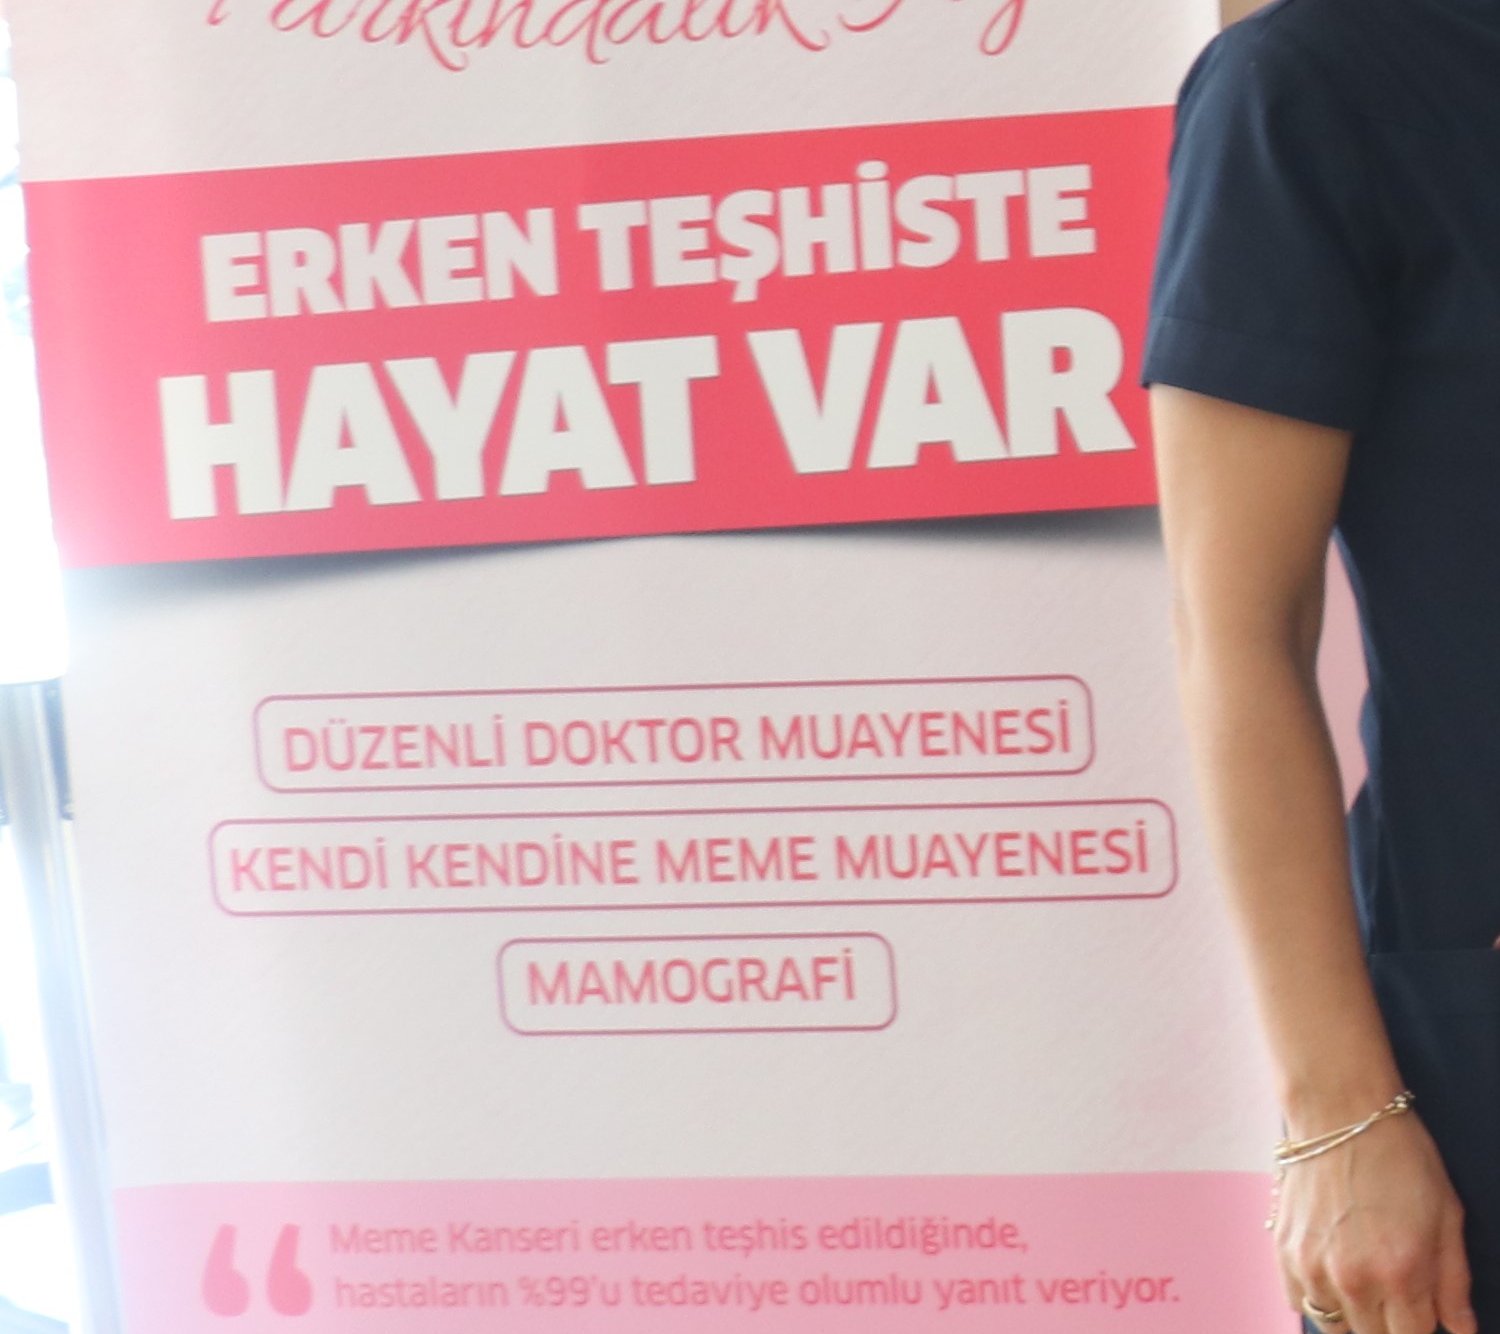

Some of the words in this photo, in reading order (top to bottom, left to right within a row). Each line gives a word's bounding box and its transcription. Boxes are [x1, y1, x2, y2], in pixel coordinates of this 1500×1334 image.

[199, 207, 558, 323] ERKEN
[577, 160, 1095, 303] TEŞHİSTE
[156, 335, 719, 522] HAYAT
[746, 307, 1136, 475] VAR
[284, 713, 507, 773] DÜZENLİ
[524, 716, 744, 767] DOKTOR
[759, 698, 1071, 761] MUAYENESİ
[231, 836, 389, 892] KENDİ
[406, 832, 640, 889] KENDİNE
[655, 835, 819, 884] MEME
[835, 819, 1149, 880] MUAYENESİ
[527, 947, 856, 1005] MAMOGRAFİ
[329, 1222, 437, 1254] Meme
[448, 1219, 581, 1254] Kanseri
[592, 1220, 693, 1253] erken
[704, 1218, 808, 1257] teşhis
[817, 1216, 1029, 1258] edildiğinde,
[336, 1277, 509, 1308] hastaların
[518, 1275, 622, 1308] %99'u
[630, 1272, 790, 1314] tedaviye
[798, 1272, 924, 1307] olumlu
[932, 1273, 1027, 1312] yanıt
[1036, 1270, 1181, 1311] veriyor.
